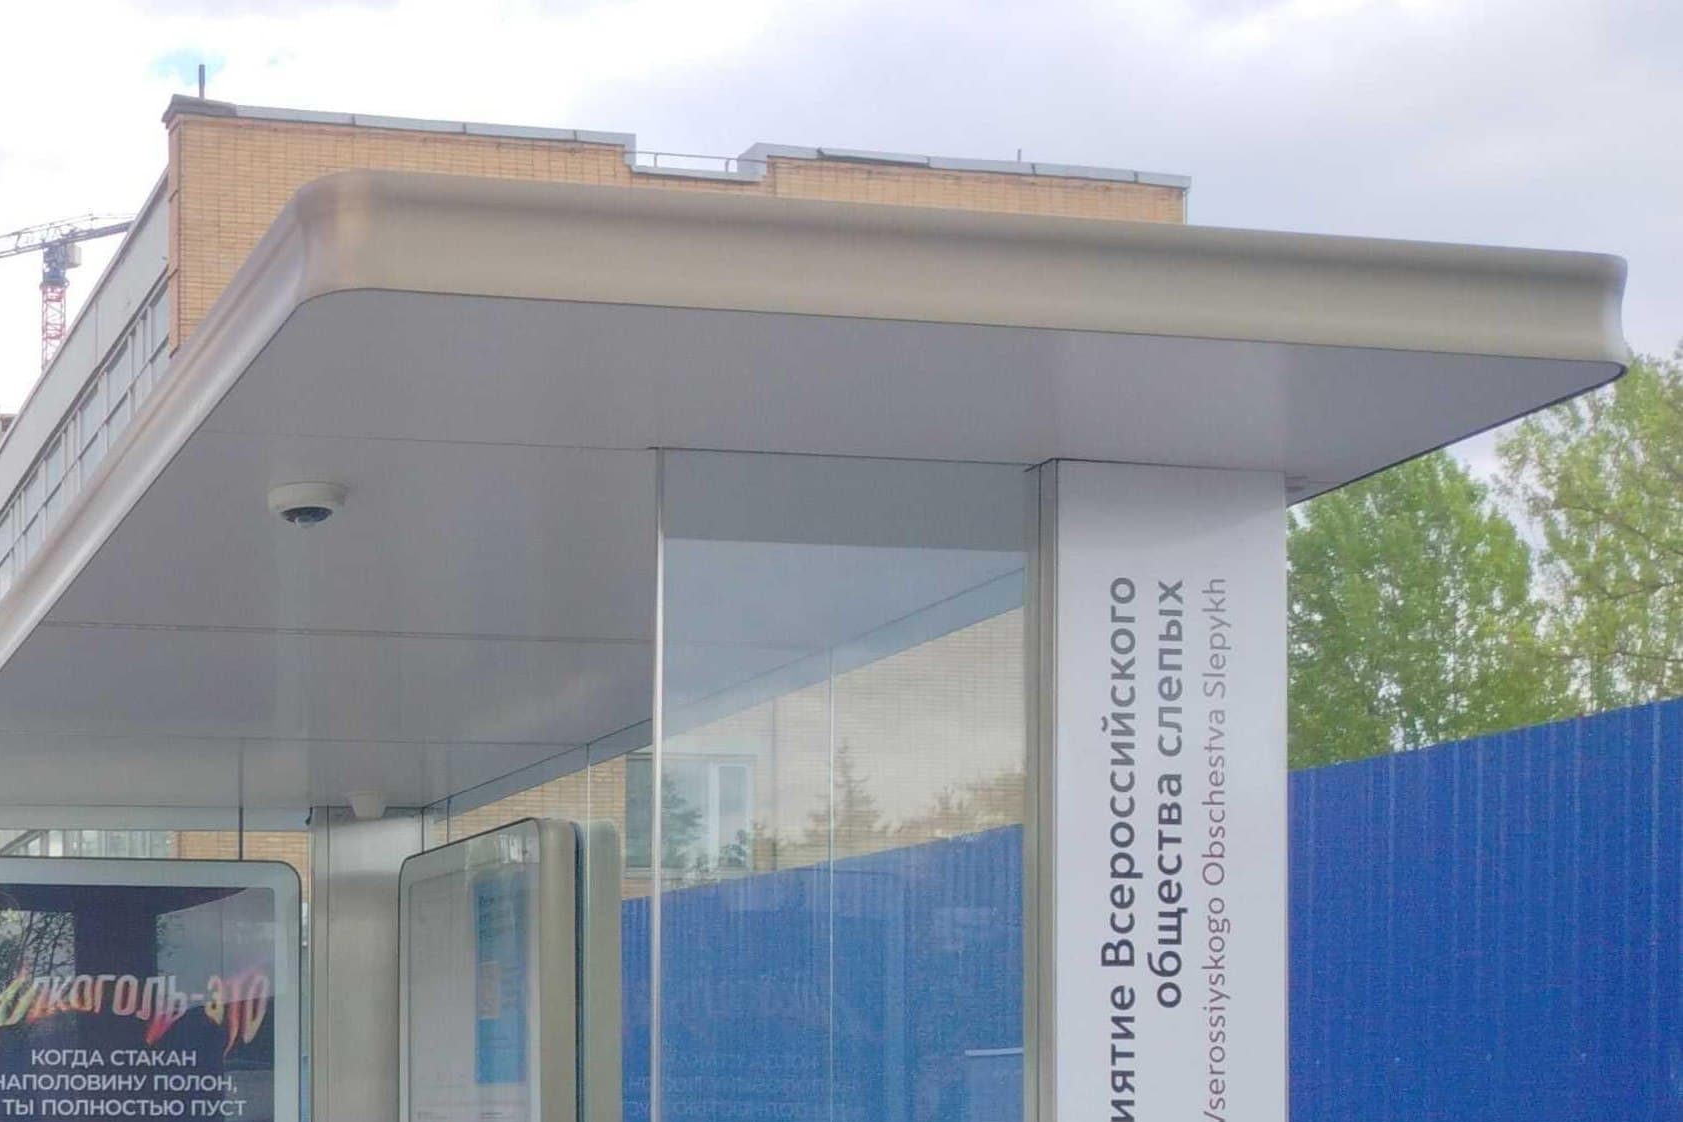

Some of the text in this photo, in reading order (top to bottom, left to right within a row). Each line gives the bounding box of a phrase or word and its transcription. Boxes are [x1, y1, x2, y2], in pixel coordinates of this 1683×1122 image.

[1202, 577, 1231, 699] Slepykh
[1100, 576, 1143, 967] Всероссийского
[1148, 579, 1185, 1009] общества слепых
[1201, 708, 1227, 887] Obschestva
[2, 1099, 35, 1116] ТЫ
[41, 1099, 185, 1117] ПОЛНОСТЬЮ
[191, 1099, 247, 1117] ПУСТ
[31, 1049, 197, 1069] КОГДА СТАКАН
[153, 1074, 238, 1093] ПОЛОН,
